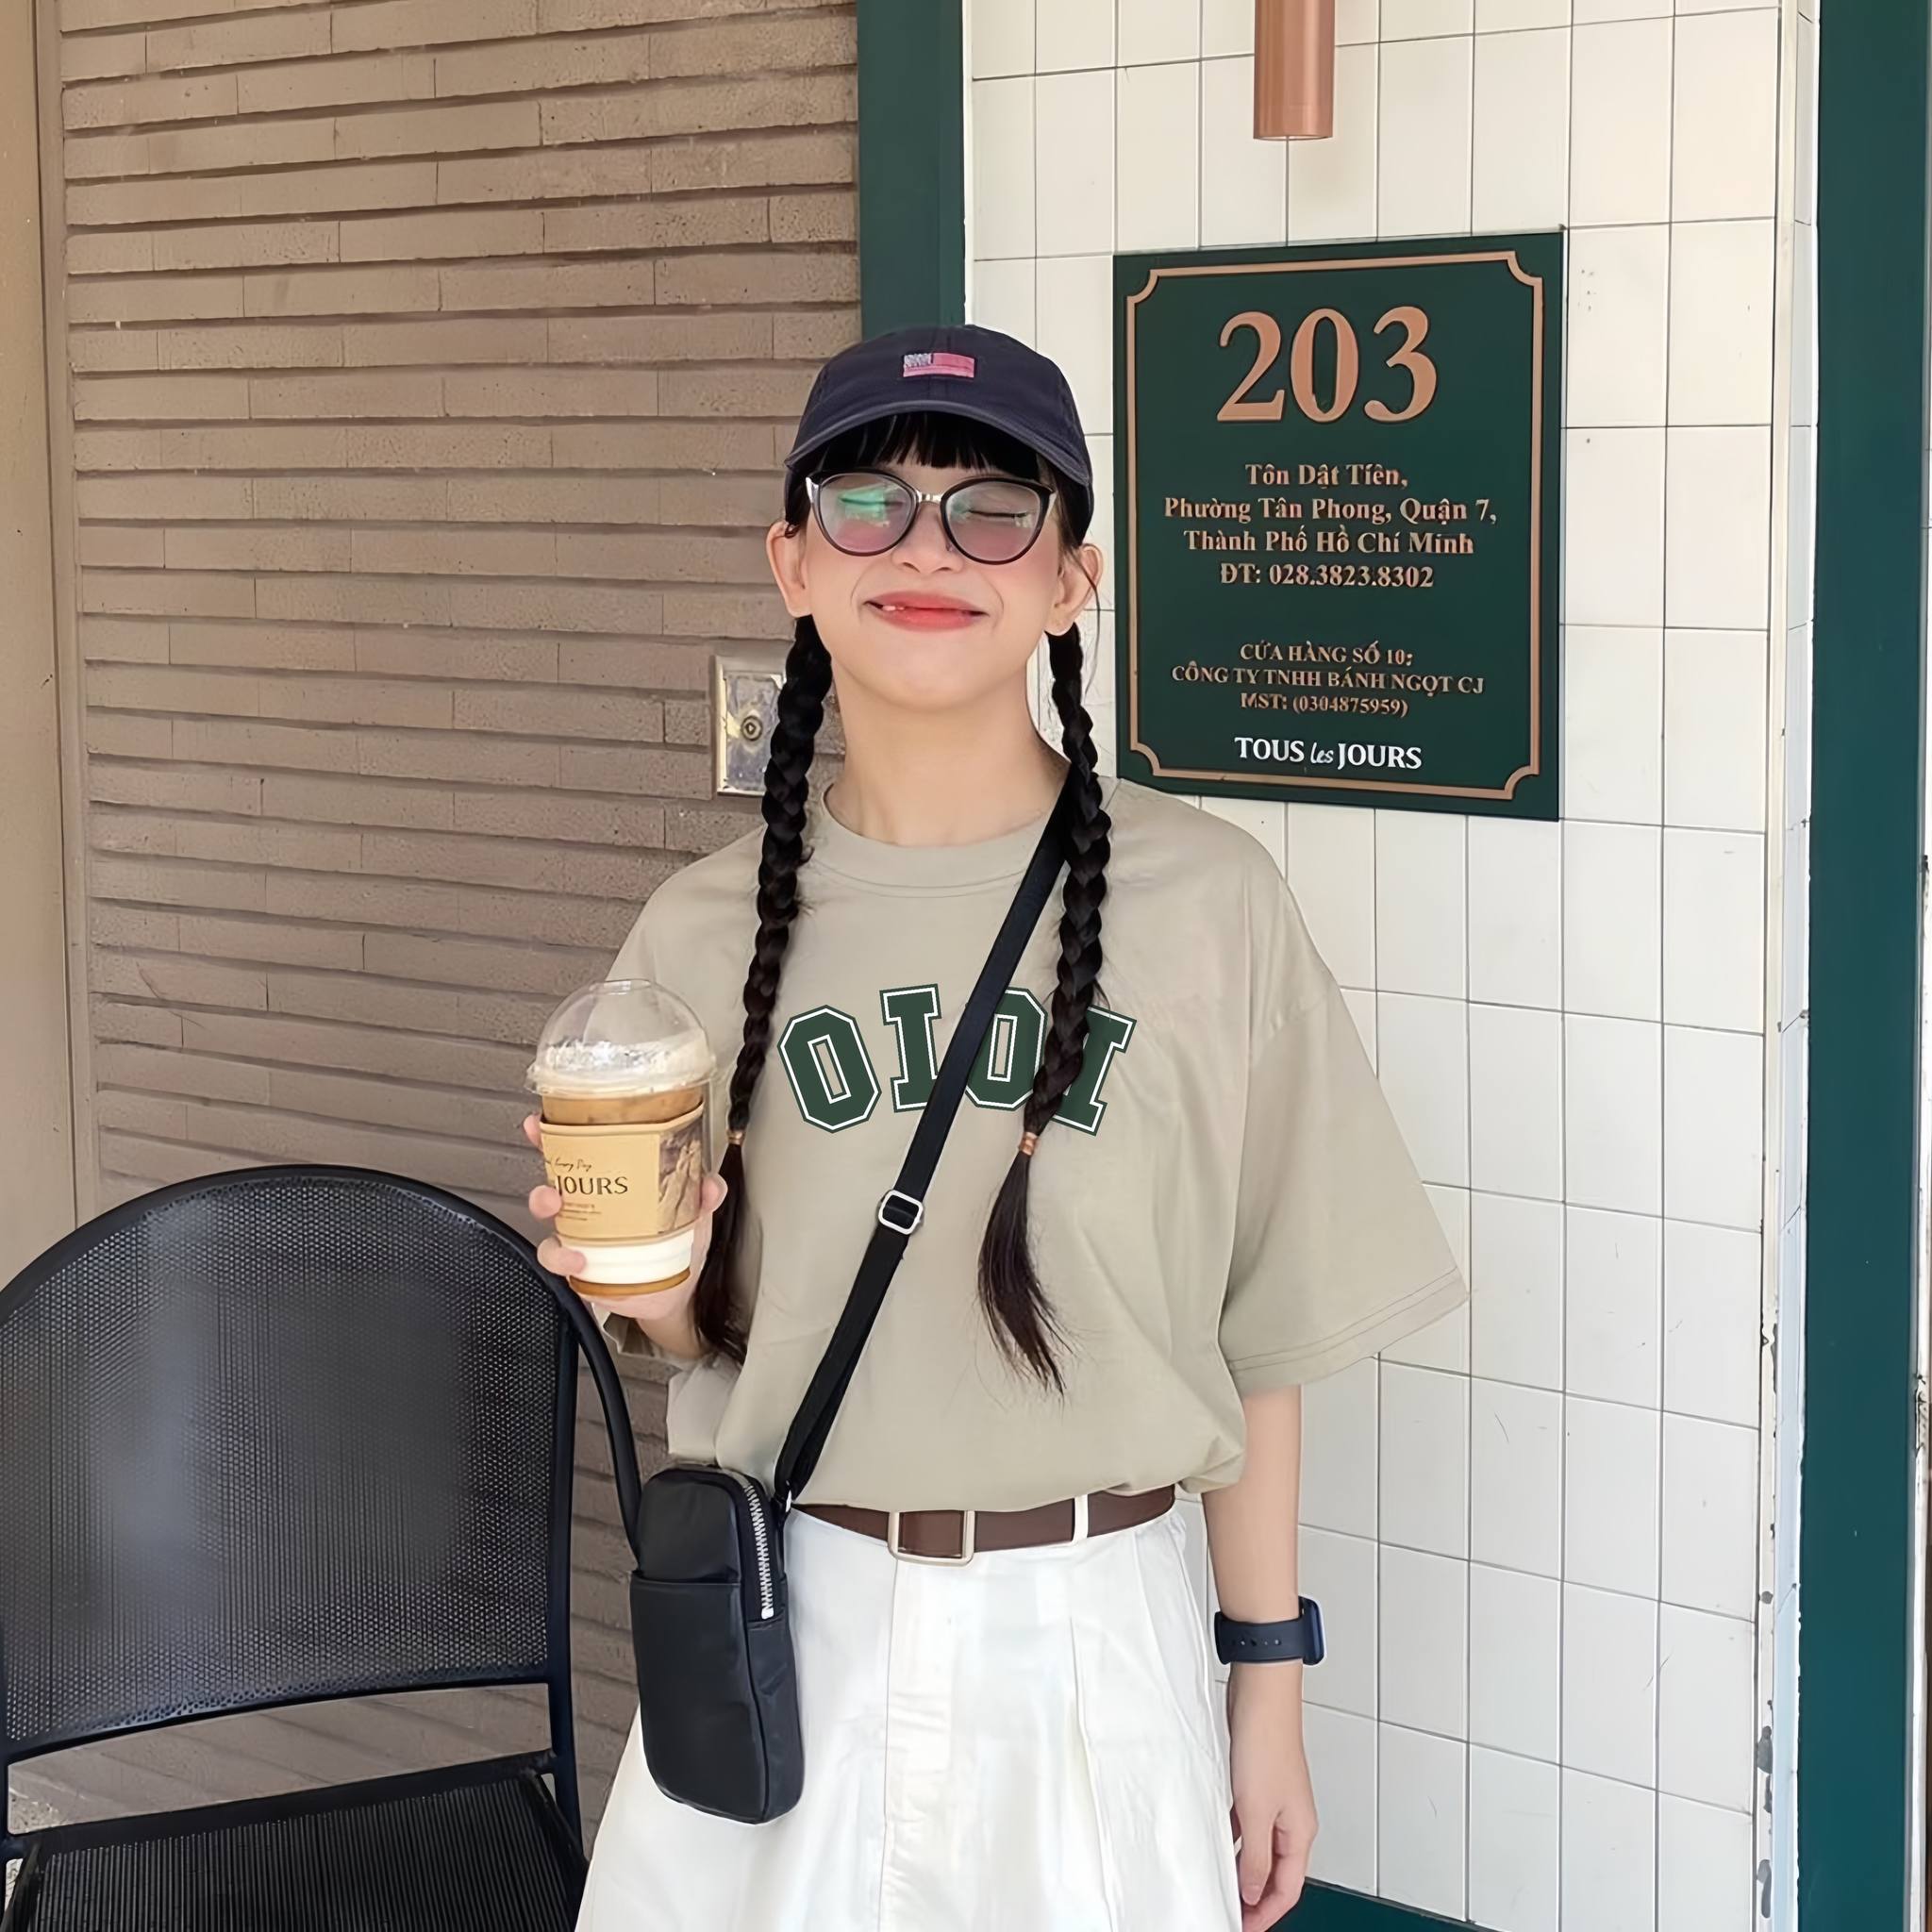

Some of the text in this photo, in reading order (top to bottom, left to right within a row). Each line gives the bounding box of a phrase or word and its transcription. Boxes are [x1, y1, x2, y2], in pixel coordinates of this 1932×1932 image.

[1217, 306, 1437, 423] 203
[1244, 463, 1290, 486] Tôn
[1298, 463, 1340, 490] Dật
[1164, 497, 1498, 525] Phường Tân Phong, Quận 7,
[1183, 524, 1474, 555] Thành Phố Hồ Chí Minh
[1221, 562, 1435, 588] ĐT: 028.3823.8302
[1289, 641, 1347, 663] HÀNG
[1352, 641, 1381, 665] SỐ
[1387, 648, 1413, 666] 10:
[1172, 660, 1485, 697] CÔNG TY TNHH BÁNH NGỌT CJ
[1241, 692, 1409, 719] MST: (0304875959)
[1234, 737, 1423, 770] TOUS les JOURS
